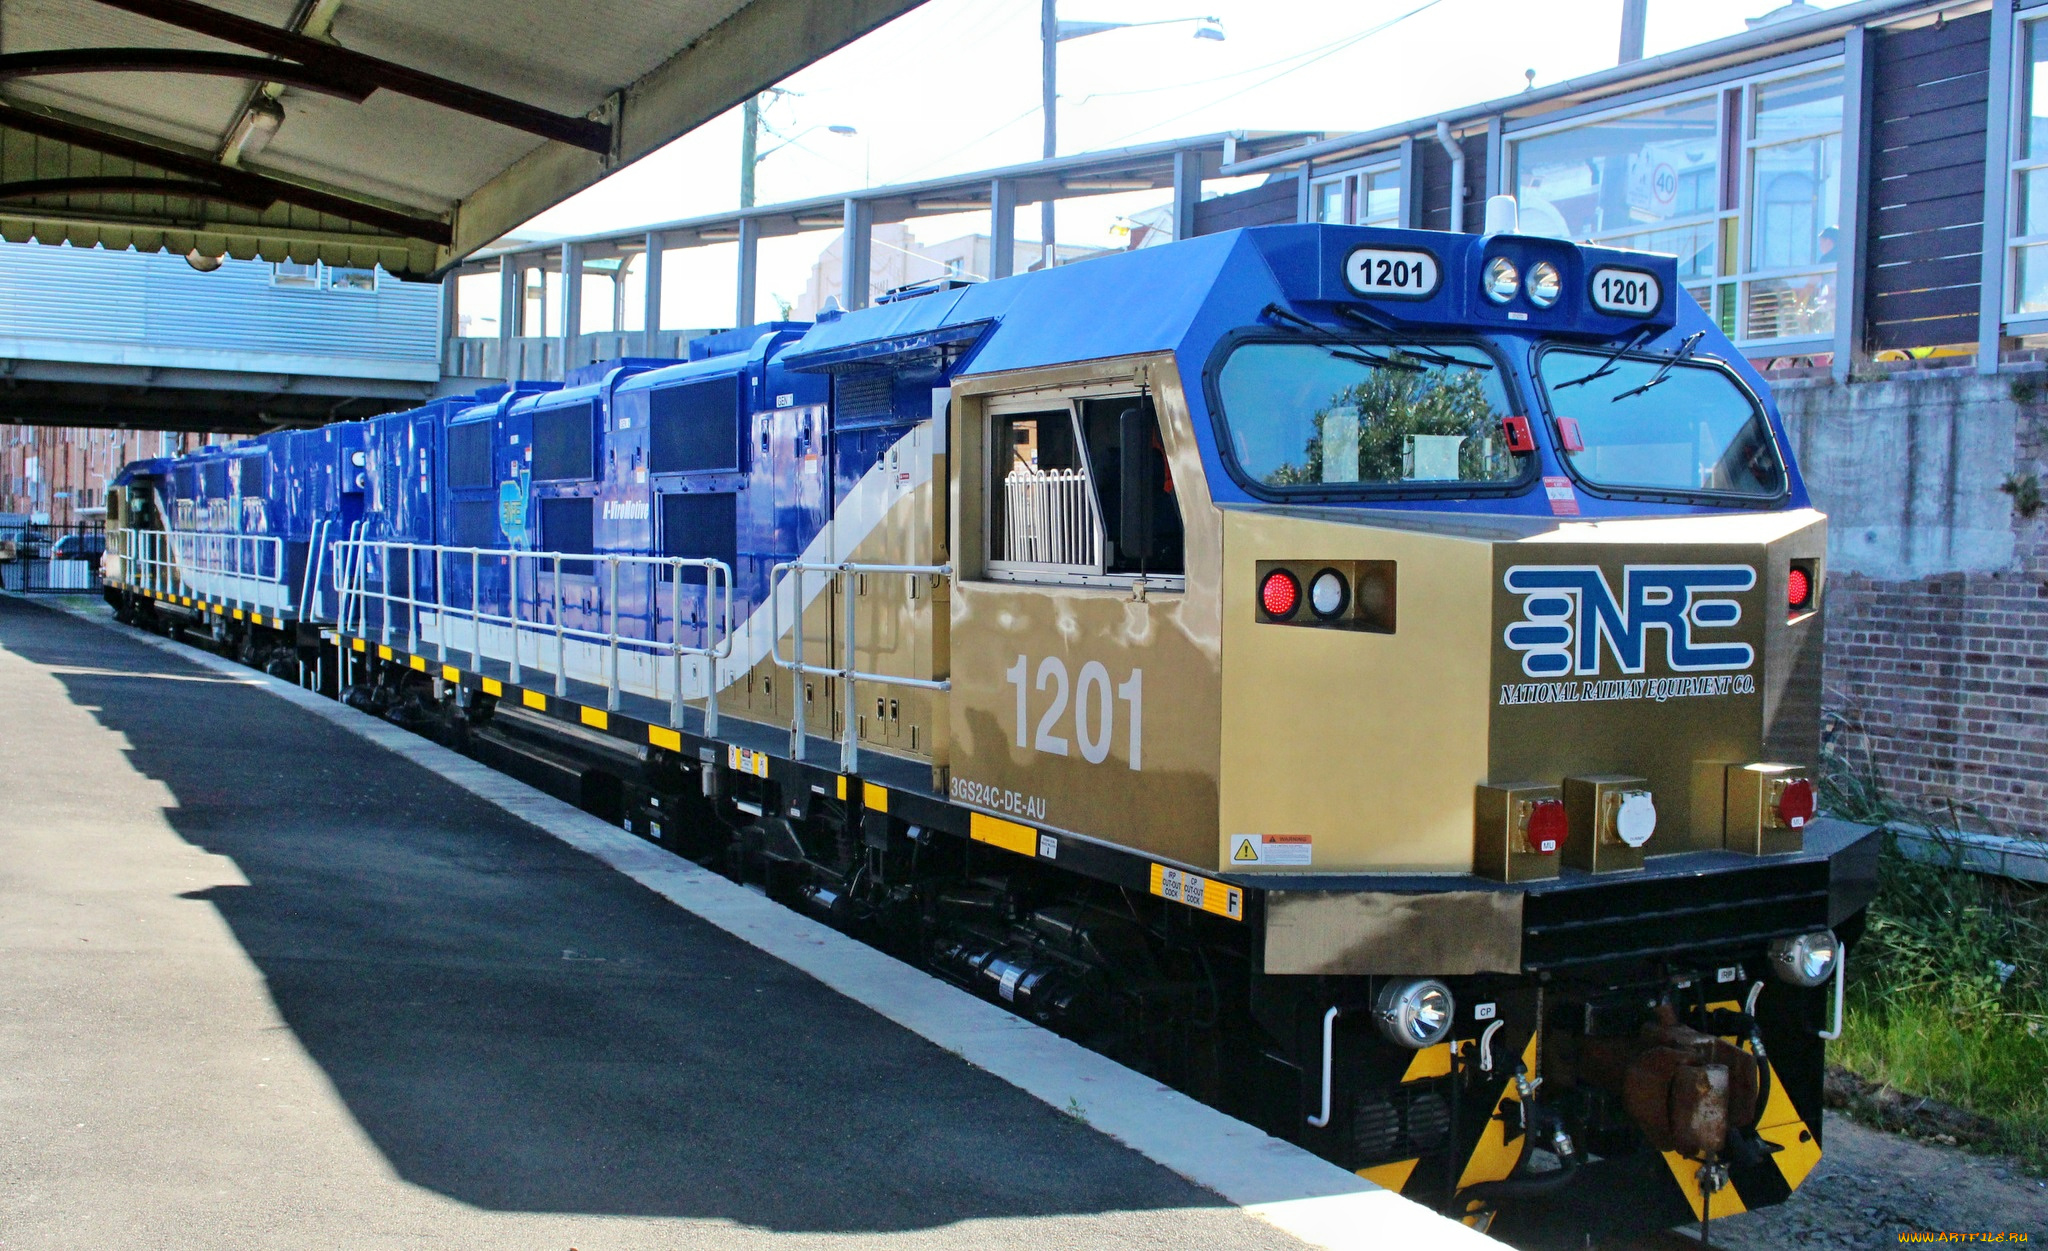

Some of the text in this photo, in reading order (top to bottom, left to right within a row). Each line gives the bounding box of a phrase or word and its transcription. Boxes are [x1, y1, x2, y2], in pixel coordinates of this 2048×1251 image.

[1656, 172, 1674, 194] 40
[1360, 258, 1423, 289] 1201
[1601, 277, 1649, 307] 1201
[1503, 564, 1757, 678] NRE
[1499, 674, 1756, 706] NATIONAL RAILWAY EQUIPMENT CO.
[1006, 654, 1142, 772] 1201
[950, 776, 1047, 821] 3GS24C-DE-AU
[1542, 840, 1555, 850] MU
[1190, 877, 1198, 885] CP
[1164, 887, 1178, 898] COCK
[1186, 894, 1200, 905] COCK
[1228, 892, 1238, 913] F
[1480, 1007, 1492, 1017] CP
